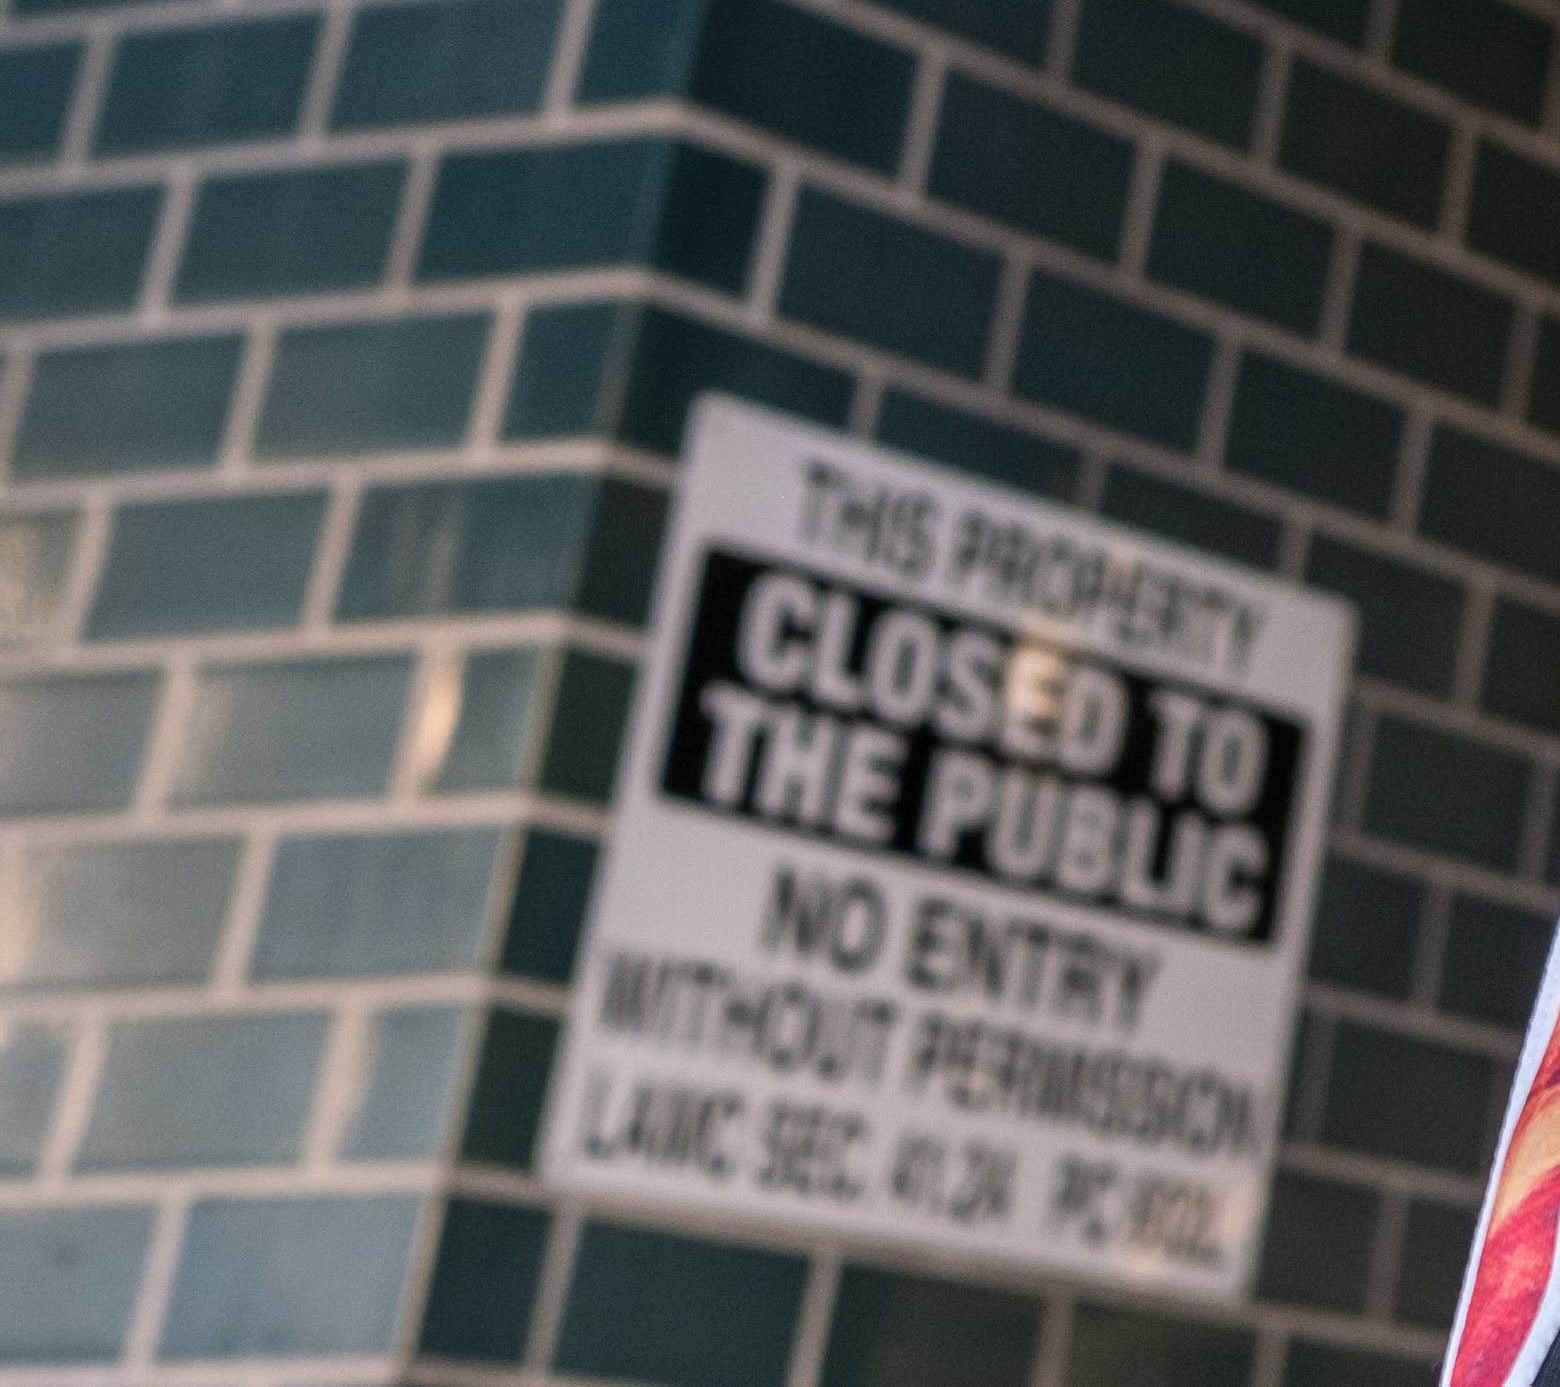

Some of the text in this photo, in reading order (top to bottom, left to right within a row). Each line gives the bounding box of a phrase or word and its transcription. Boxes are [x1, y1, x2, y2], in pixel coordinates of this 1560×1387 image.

[802, 459, 1270, 681] THIS PROPERTY
[734, 569, 1276, 817] CLOSED TO
[699, 677, 1276, 937] THE PUBLIC
[600, 949, 1266, 1164] WITHOUT PERMISSION
[758, 863, 1164, 1032] NO ENTRY
